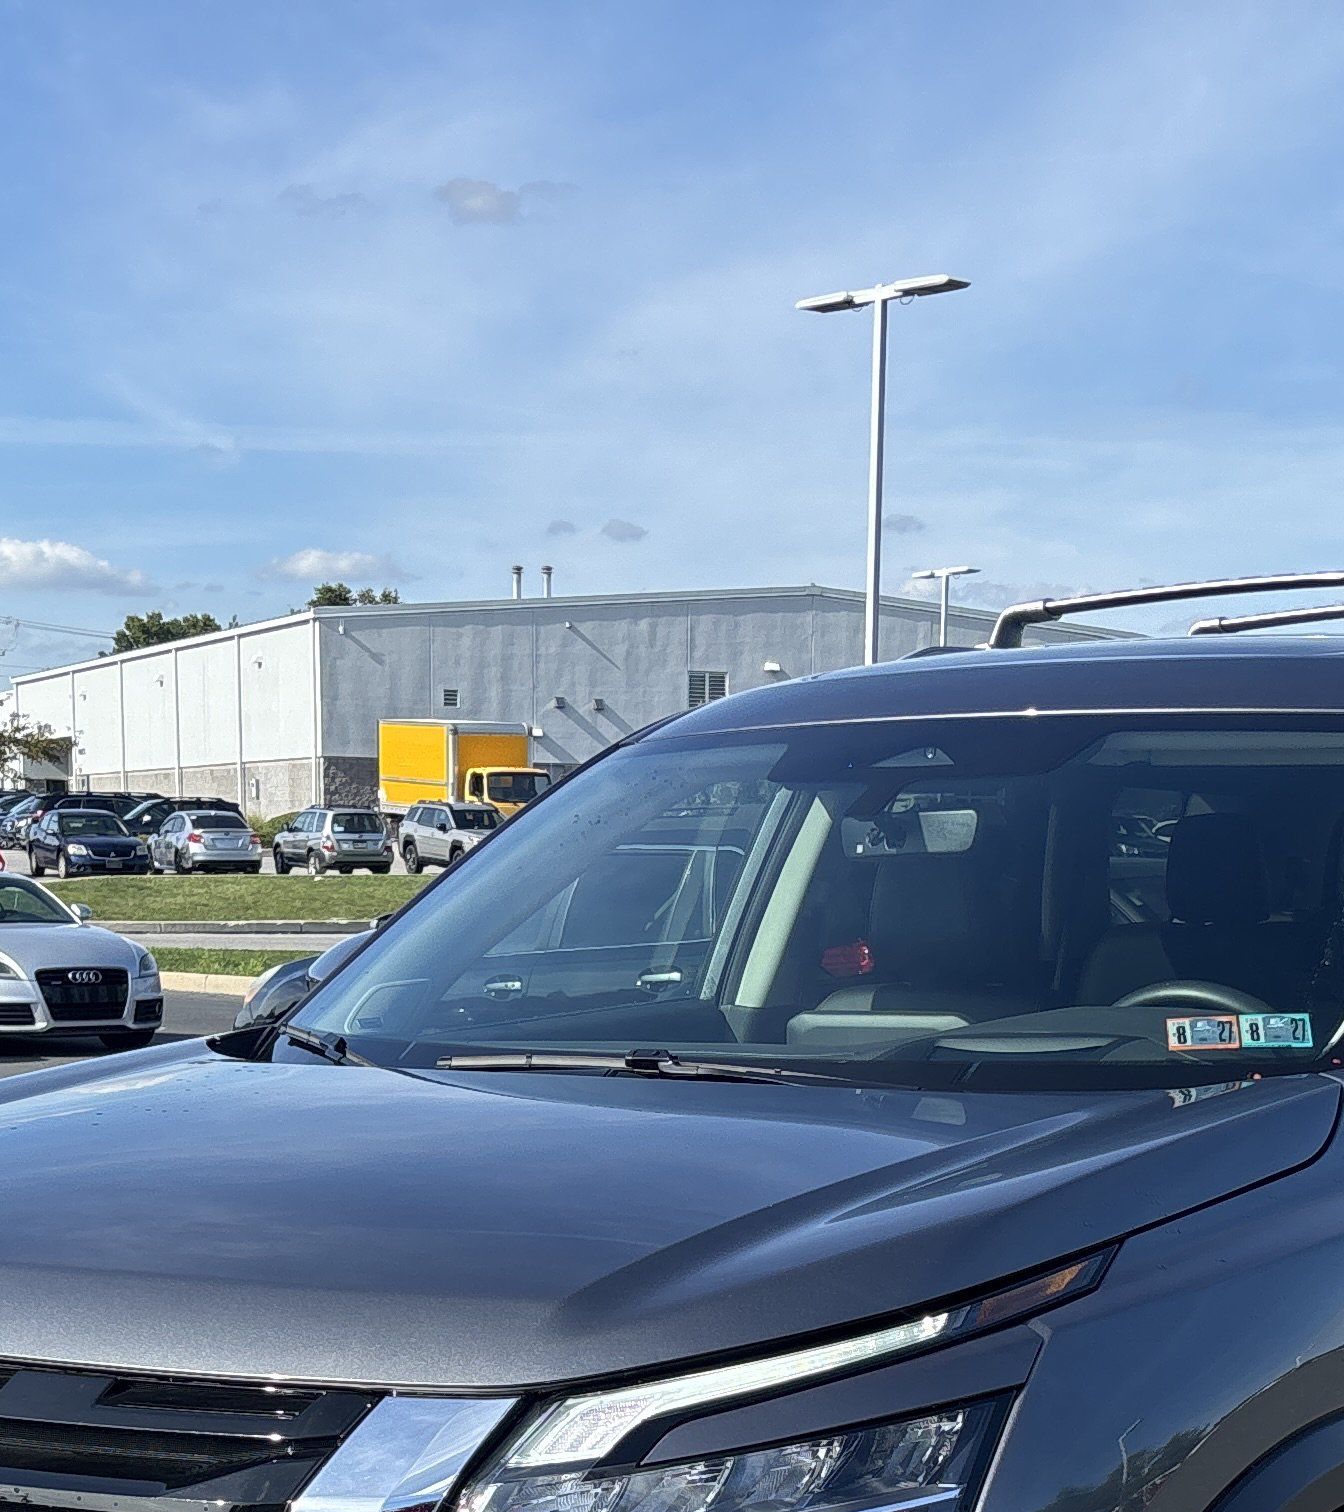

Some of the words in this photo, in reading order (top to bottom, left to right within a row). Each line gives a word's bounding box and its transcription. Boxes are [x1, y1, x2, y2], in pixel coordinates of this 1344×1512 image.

[1176, 1025, 1188, 1045] 8
[1216, 1020, 1233, 1044] 27
[1249, 1022, 1261, 1042] 8
[1289, 1018, 1306, 1042] 27
